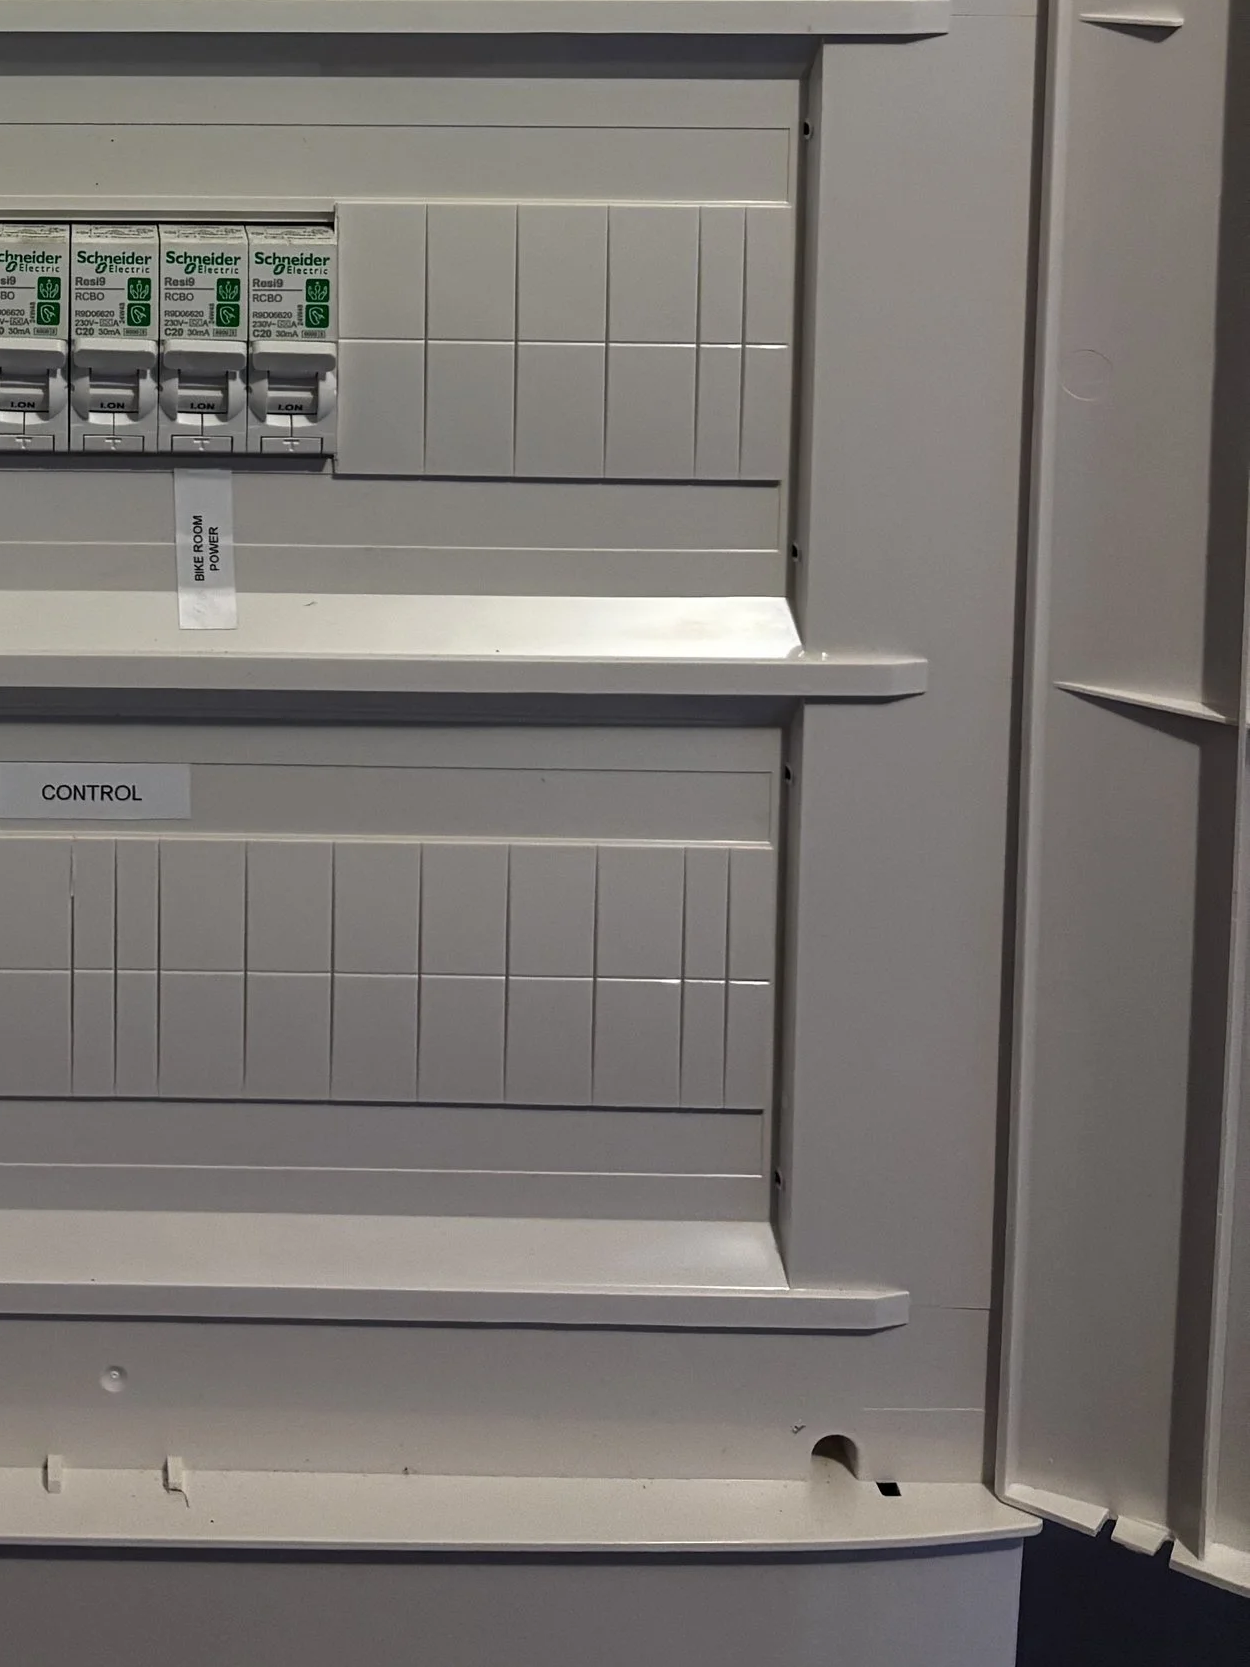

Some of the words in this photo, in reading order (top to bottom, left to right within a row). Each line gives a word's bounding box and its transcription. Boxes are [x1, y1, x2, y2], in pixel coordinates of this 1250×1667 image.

[77, 251, 152, 265] Schneider
[166, 251, 241, 266] Schneider
[254, 251, 330, 266] Schneider
[192, 515, 204, 553] ROOM
[208, 526, 220, 572] POWER
[193, 556, 205, 582] BIKE
[41, 784, 143, 802] CONTROL
